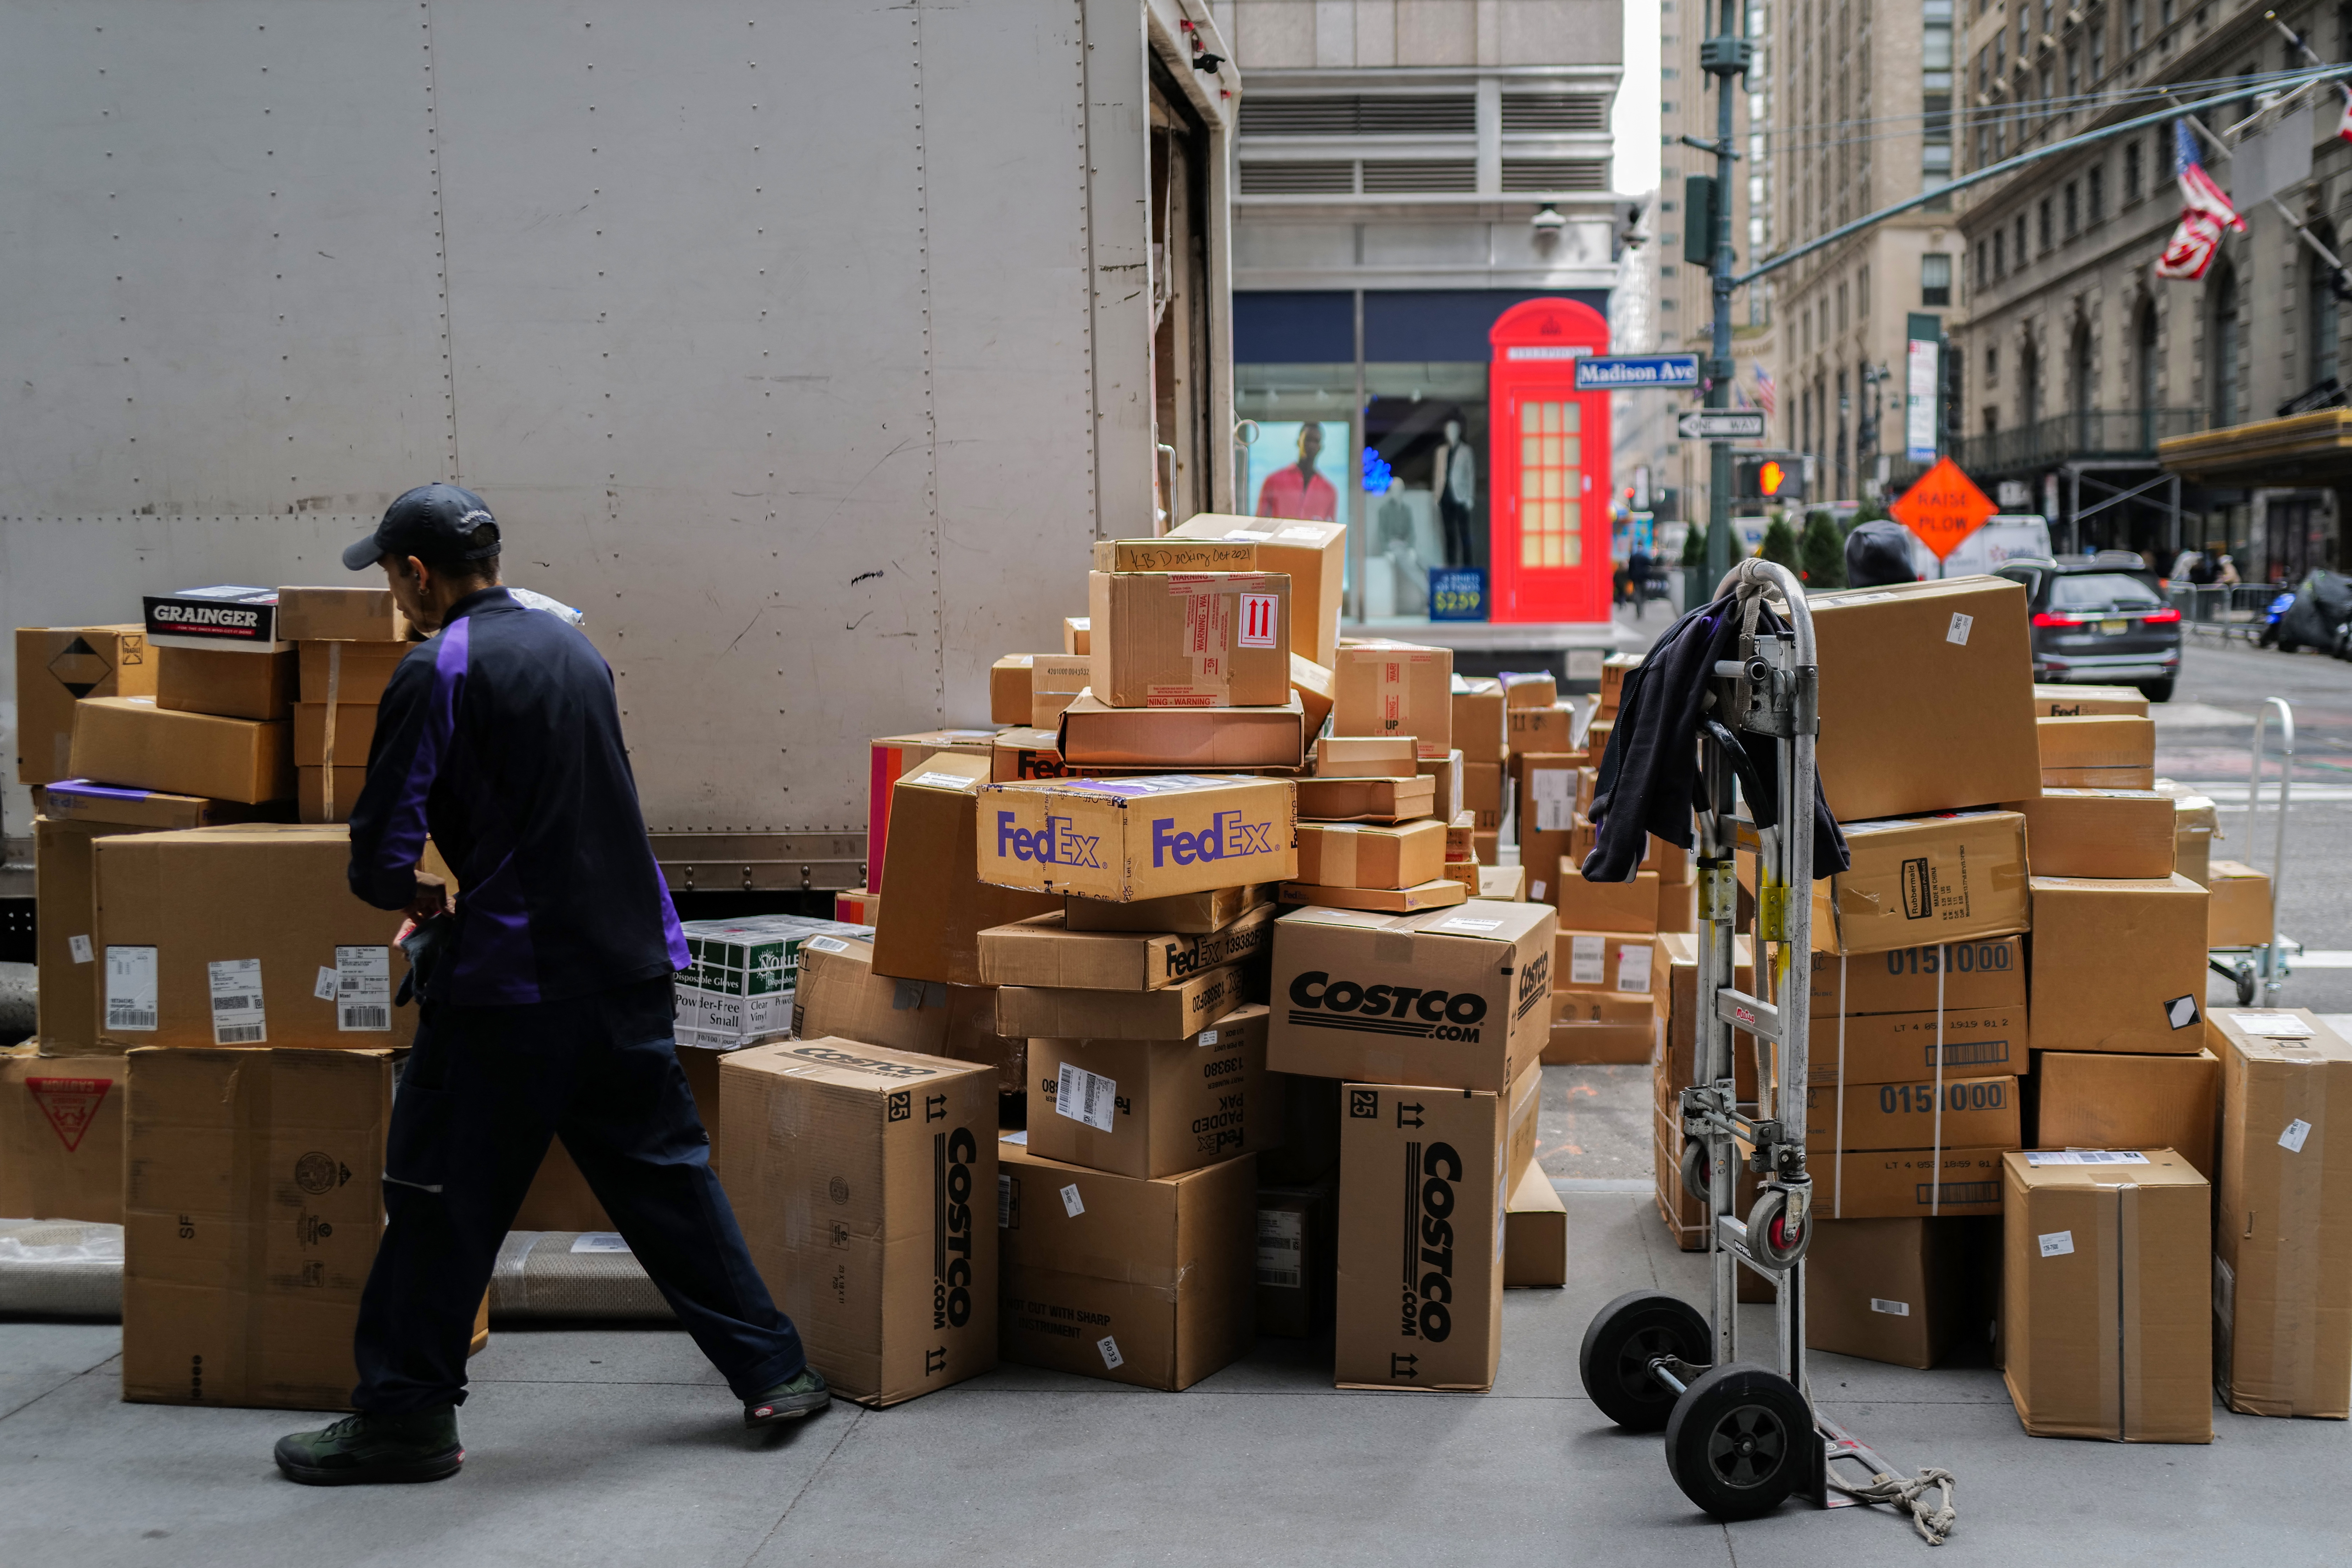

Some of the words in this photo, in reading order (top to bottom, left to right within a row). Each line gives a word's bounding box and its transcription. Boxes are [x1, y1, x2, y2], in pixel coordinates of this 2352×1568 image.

[1580, 363, 1657, 382] Madison
[1659, 361, 1696, 380] Ave
[1690, 420, 1711, 431] ONE
[1731, 420, 1759, 431] WAY
[1918, 493, 1966, 506] RAISE
[1919, 517, 1967, 531] PLOW
[1213, 548, 1230, 561] Oct
[1232, 548, 1250, 560] 2021
[1172, 572, 1208, 581] WARNING
[155, 605, 258, 627] GRAINGER
[1197, 615, 1206, 651] WARNING
[1386, 720, 1399, 730] UP
[997, 811, 1101, 869] FedEx
[1152, 810, 1273, 868] FedEx
[1909, 865, 1918, 914] Rubbermaid
[1224, 928, 1234, 937] PART
[1234, 924, 1250, 935] NUMBER
[1165, 935, 1221, 978] FedEx
[1225, 926, 1269, 955] 139382F20
[673, 972, 712, 985] Disposable
[714, 977, 739, 988] Gloves
[1519, 950, 1548, 1002] COSTCO
[676, 994, 740, 1013] Powder-Free
[751, 1001, 768, 1010] Clear
[1193, 981, 1225, 1013] 139382F20
[1289, 970, 1487, 1025] COSTCO
[710, 1013, 739, 1027] Small
[751, 1010, 767, 1023] Vinyl
[698, 1034, 718, 1043] 10/100
[1226, 1029, 1236, 1037] BOX
[1428, 1025, 1480, 1043] .COM
[1214, 1044, 1226, 1052] UNIT
[1227, 1041, 1238, 1049] PER
[793, 1048, 937, 1077] COSTCO
[1204, 1057, 1244, 1078] 139380
[1208, 1079, 1230, 1090] NUMBER
[1231, 1076, 1244, 1084] PART
[889, 1093, 909, 1119] 25
[1219, 1093, 1243, 1111] PAK
[1353, 1093, 1375, 1116] 25
[1192, 1109, 1243, 1134] PADDED
[1197, 1127, 1244, 1155] FedEx
[179, 1214, 194, 1239] SF
[947, 1127, 976, 1328] COSTCO
[1419, 1141, 1462, 1343] COSTCO
[1735, 1241, 1753, 1259] wewo
[839, 1264, 845, 1273] 23
[933, 1279, 946, 1330] .COM
[1006, 1298, 1025, 1311] NOT
[1028, 1301, 1046, 1315] CUT
[1049, 1305, 1074, 1321] WITH
[1077, 1310, 1111, 1326] SHARP
[1402, 1284, 1417, 1336] .COM
[1018, 1317, 1081, 1339] INSTRUMENT
[1104, 1340, 1118, 1362] 0033
